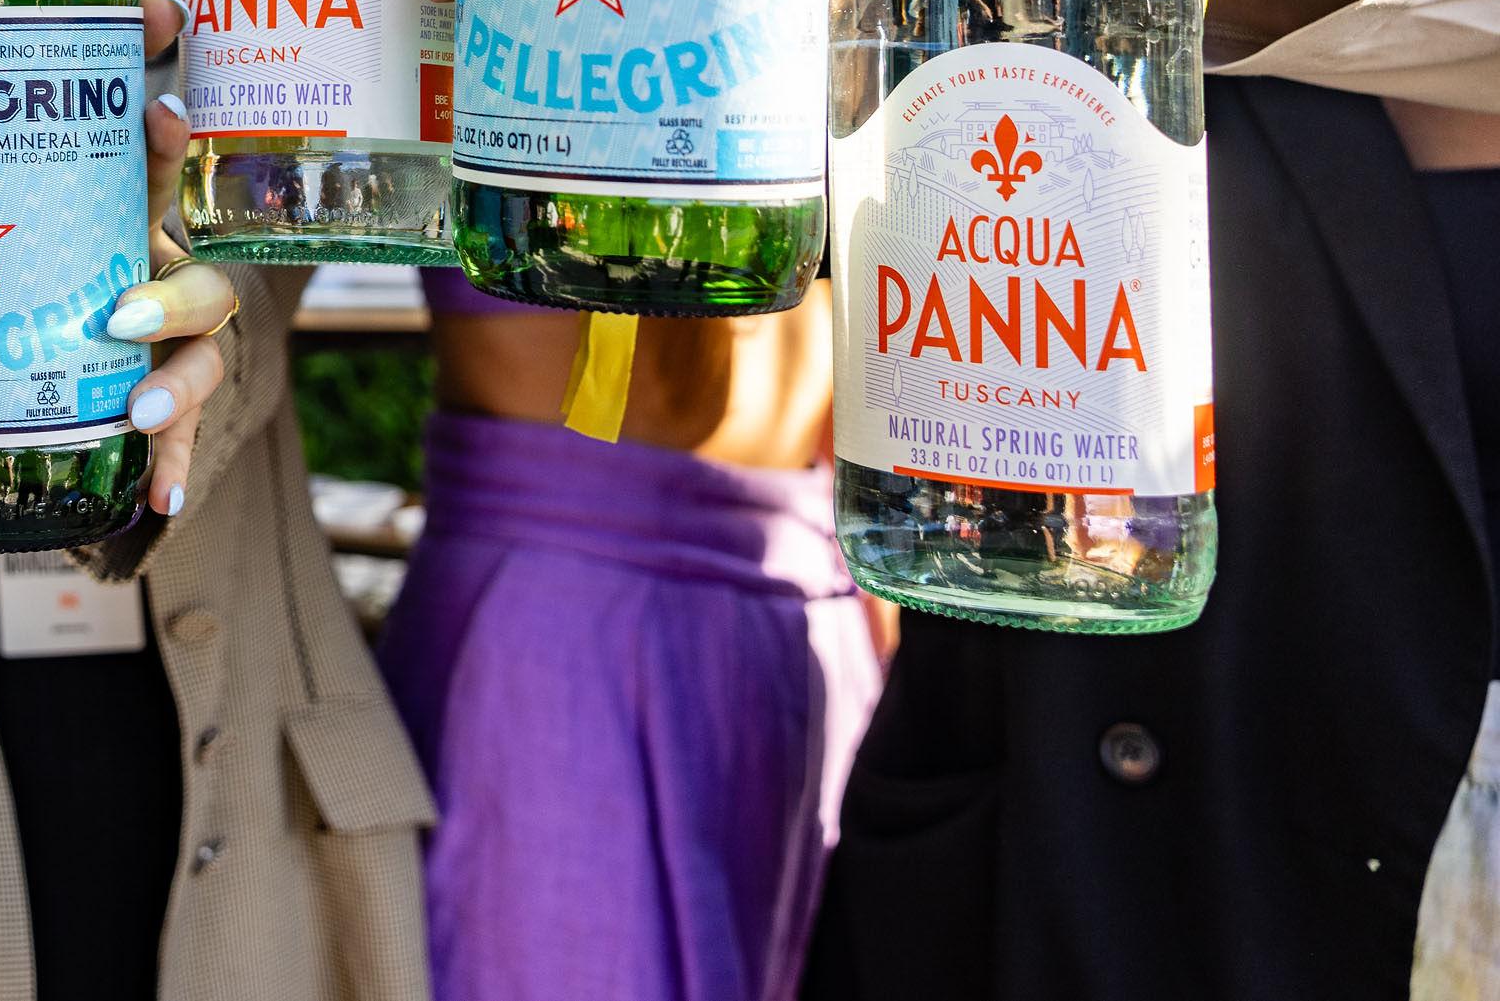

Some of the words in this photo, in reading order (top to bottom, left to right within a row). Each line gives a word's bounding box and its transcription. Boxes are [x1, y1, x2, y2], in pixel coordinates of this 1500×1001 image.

[40, 44, 78, 58] TERME
[204, 45, 302, 67] TUSCANY
[229, 82, 288, 107] SPRING
[295, 82, 353, 107] WATER
[902, 81, 946, 124] ELEVATE
[948, 66, 987, 89] YOUR
[993, 66, 1036, 82] TASTE
[1042, 71, 1117, 128] EXPERIENCE
[208, 111, 219, 127] FL
[220, 111, 234, 127] OZ
[236, 110, 267, 128] (1.06
[272, 109, 293, 128] QT)
[297, 109, 311, 128] (1
[316, 109, 329, 128] L)
[87, 128, 131, 148] WATER
[464, 127, 476, 145] OZ
[478, 129, 504, 150] (1.06
[507, 131, 532, 154] QT)
[536, 133, 549, 155] (1
[556, 135, 572, 156] L)
[45, 151, 79, 163] ADDED
[936, 215, 1085, 268] ACQUA
[30, 371, 48, 382] GLASS
[48, 370, 67, 381] BOTTLE
[82, 361, 100, 374] BEST
[110, 358, 125, 369] USED
[938, 380, 1082, 410] TUSCANY
[25, 408, 42, 418] FULLY
[41, 405, 72, 417] RECYCLABLE
[888, 413, 973, 450] NATURAL
[981, 425, 1064, 459] SPRING
[1073, 432, 1140, 461] WATER
[910, 447, 941, 468] 33.8
[947, 452, 962, 471] FL
[968, 454, 988, 474] OZ
[995, 458, 1038, 479] (1.06
[1045, 462, 1071, 483] QT)
[1078, 464, 1094, 483] (1
[1100, 465, 1115, 485] L)
